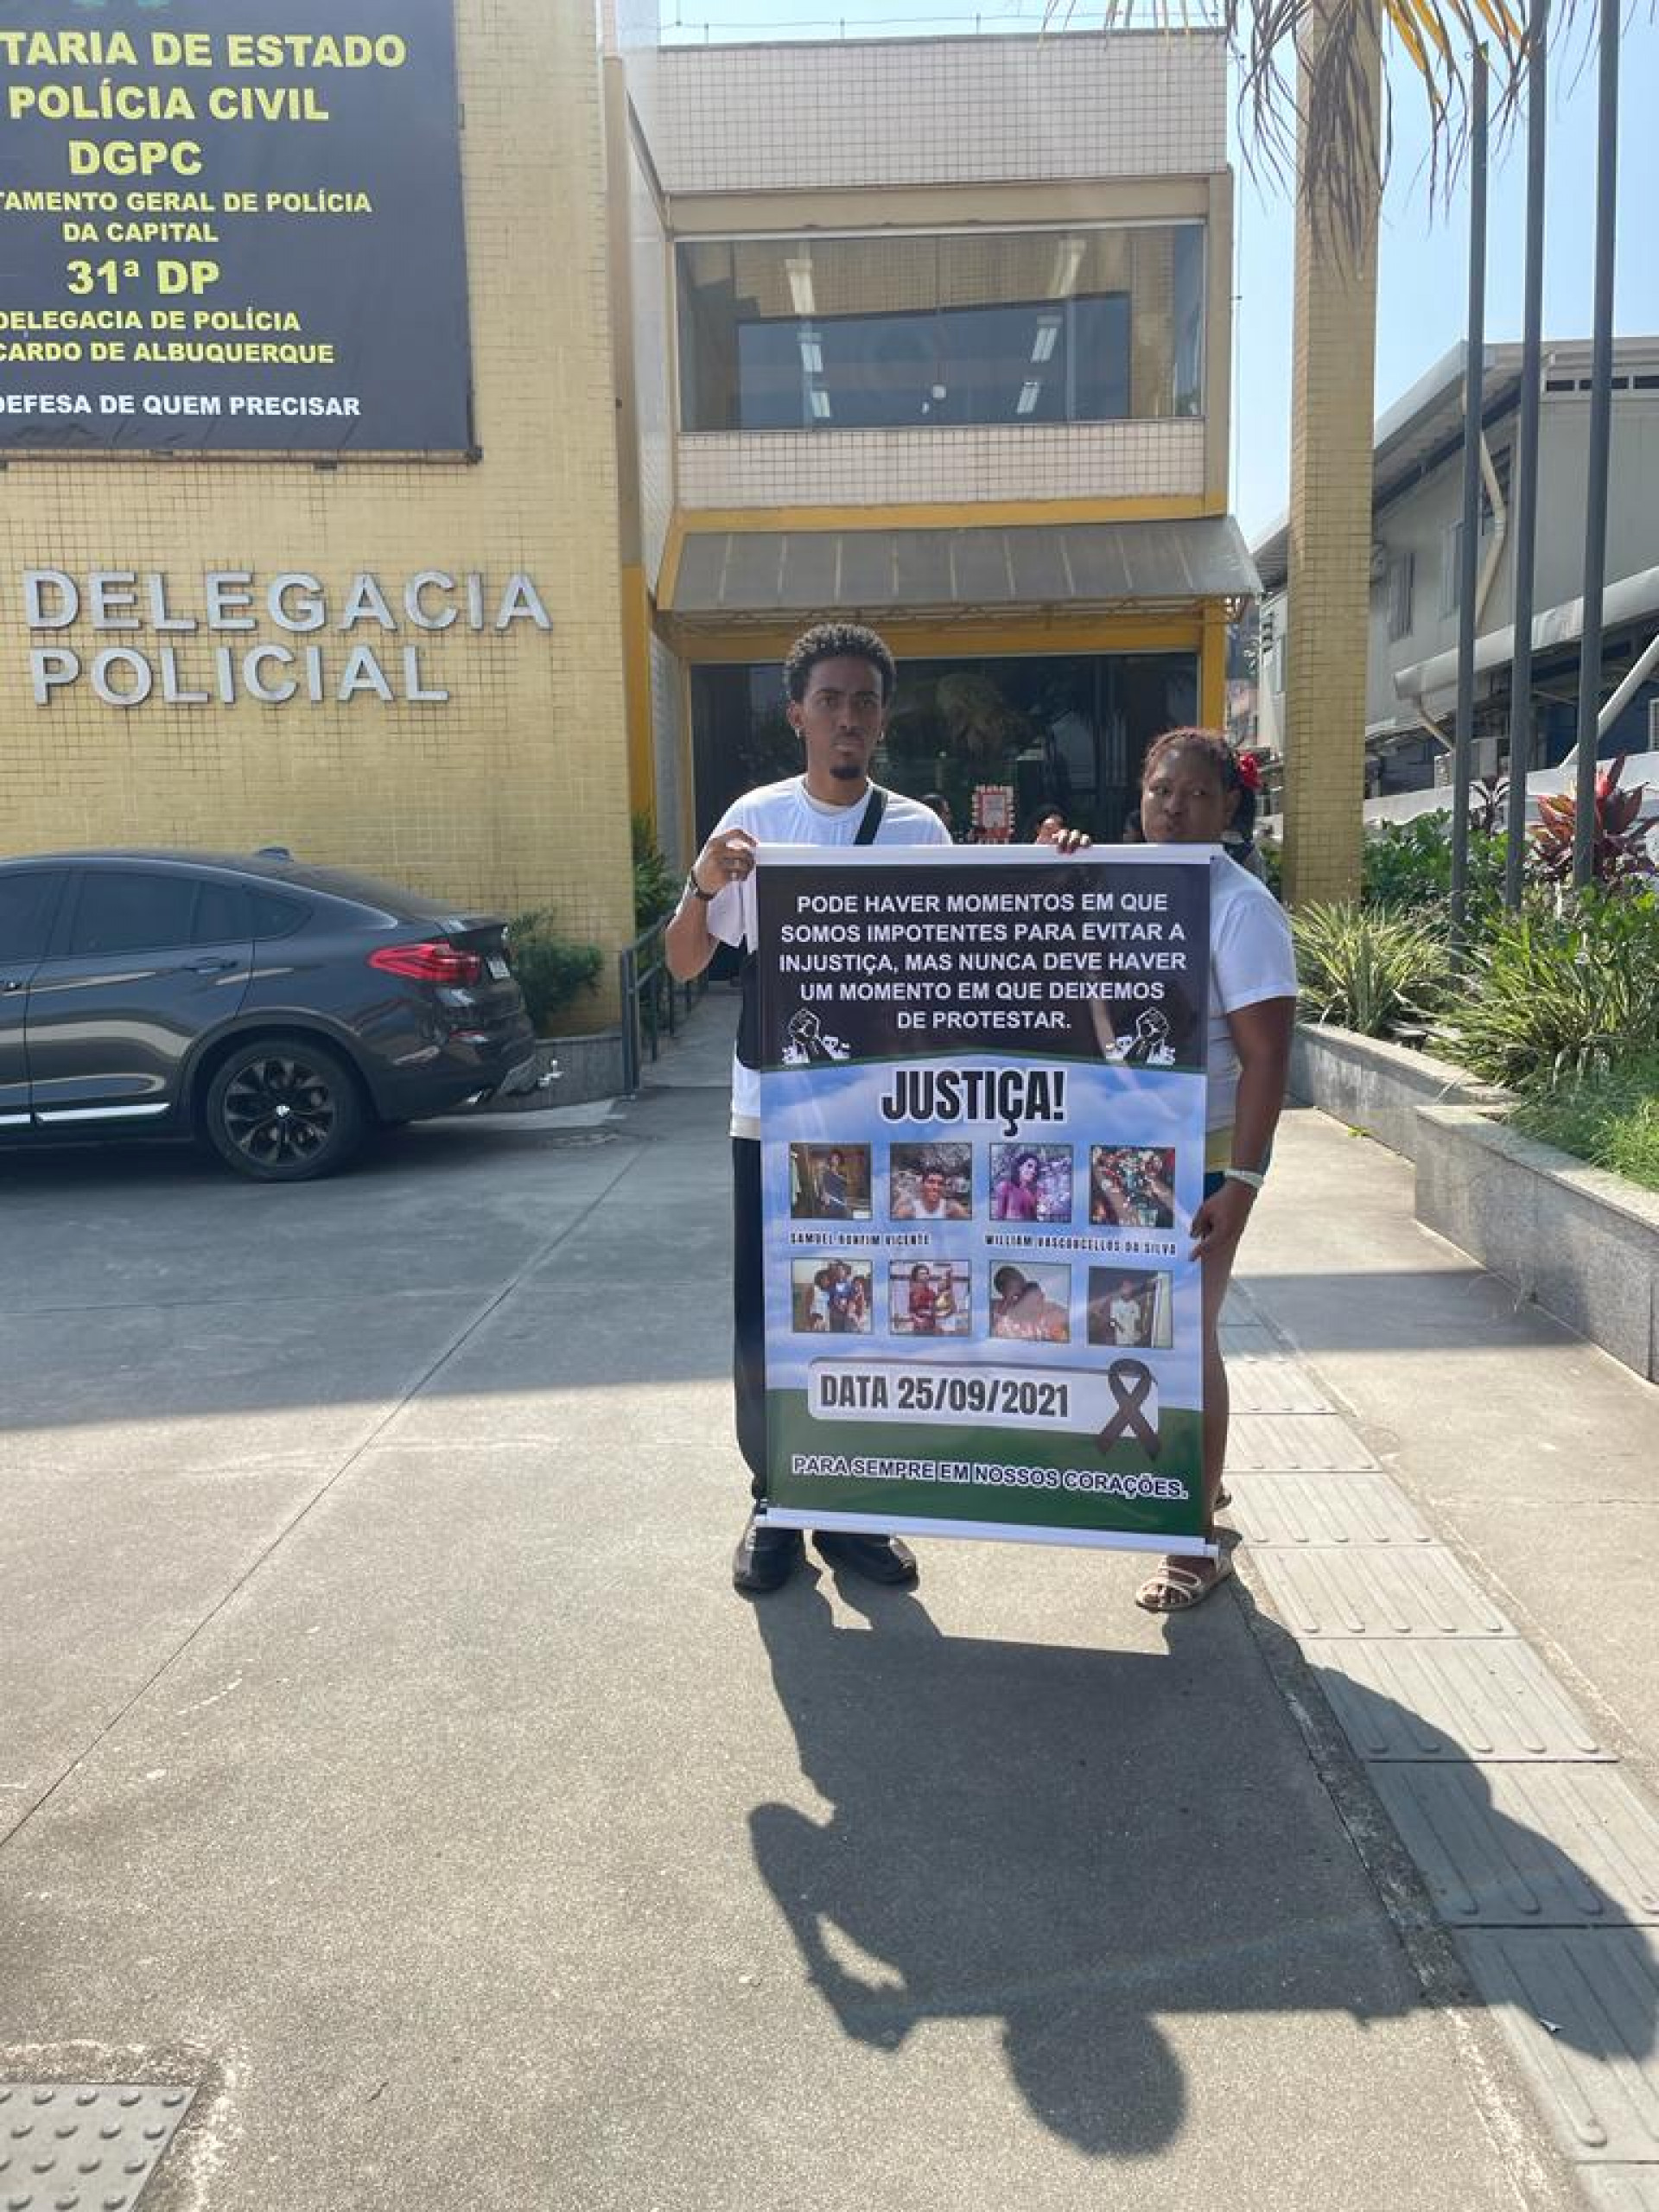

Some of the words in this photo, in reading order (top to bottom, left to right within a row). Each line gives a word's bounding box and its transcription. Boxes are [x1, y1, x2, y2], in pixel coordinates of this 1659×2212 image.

[0, 30, 138, 66] TARIA
[151, 32, 213, 67] DE
[227, 33, 407, 68] ESTADO
[9, 77, 195, 119] POLÍCIA
[208, 87, 329, 121] CIVIL
[68, 140, 202, 175] DGPC
[0, 191, 118, 211] AMENTO
[127, 192, 215, 212] GERAL
[223, 192, 258, 213] DE
[266, 188, 372, 213] POLÍCIA
[63, 222, 99, 243] DA
[106, 222, 219, 243] CAPITAL
[67, 260, 140, 295] 31ª
[156, 260, 219, 295] DP
[150, 310, 186, 330] DE
[194, 306, 302, 331] POLÍCIA
[90, 342, 125, 361] DE
[133, 343, 335, 364] ALBUQUERQUE
[99, 395, 135, 415] DE
[143, 395, 221, 416] QUEM
[229, 397, 361, 416] PRECISAR
[22, 569, 553, 631] DELEGACIA
[29, 645, 449, 705] POLICIAL
[797, 895, 859, 913] PODE
[865, 894, 940, 912] HAVER
[947, 893, 1075, 912] MOMENTOS
[1081, 893, 1114, 911] EM
[1121, 893, 1168, 912] QUE
[781, 924, 861, 944] SOMOS
[868, 923, 1007, 943] IMPOTENTES
[1014, 923, 1077, 941] PARA
[1082, 922, 1163, 941] EVITAR
[1168, 922, 1186, 940] A
[779, 954, 899, 976] INJUSTIÇA,
[905, 953, 953, 971] MAS
[958, 952, 1037, 970] NUNCA
[1043, 952, 1103, 969] DEVE
[1109, 952, 1187, 970] HAVER
[800, 982, 833, 1001] UM
[840, 982, 951, 1001] MOMENTO
[958, 982, 990, 999] EM
[995, 982, 1042, 1001] QUE
[1049, 982, 1166, 1000] DEIXEMOS
[898, 1011, 926, 1029] DE
[932, 1010, 1072, 1029] PROTESTAR.
[881, 1070, 1066, 1138] JUSTIÇA!
[790, 1231, 833, 1245] SAMUEL
[984, 1235, 1033, 1246] WILLIAM
[820, 1375, 889, 1408] DATA
[897, 1377, 1069, 1418] 25/09/2021
[792, 1456, 849, 1474] PARA
[850, 1458, 936, 1481] SEMPRE
[938, 1462, 970, 1483] EM
[973, 1464, 1060, 1489] NOSSOS
[1063, 1469, 1189, 1499] CORAÇÕES.
